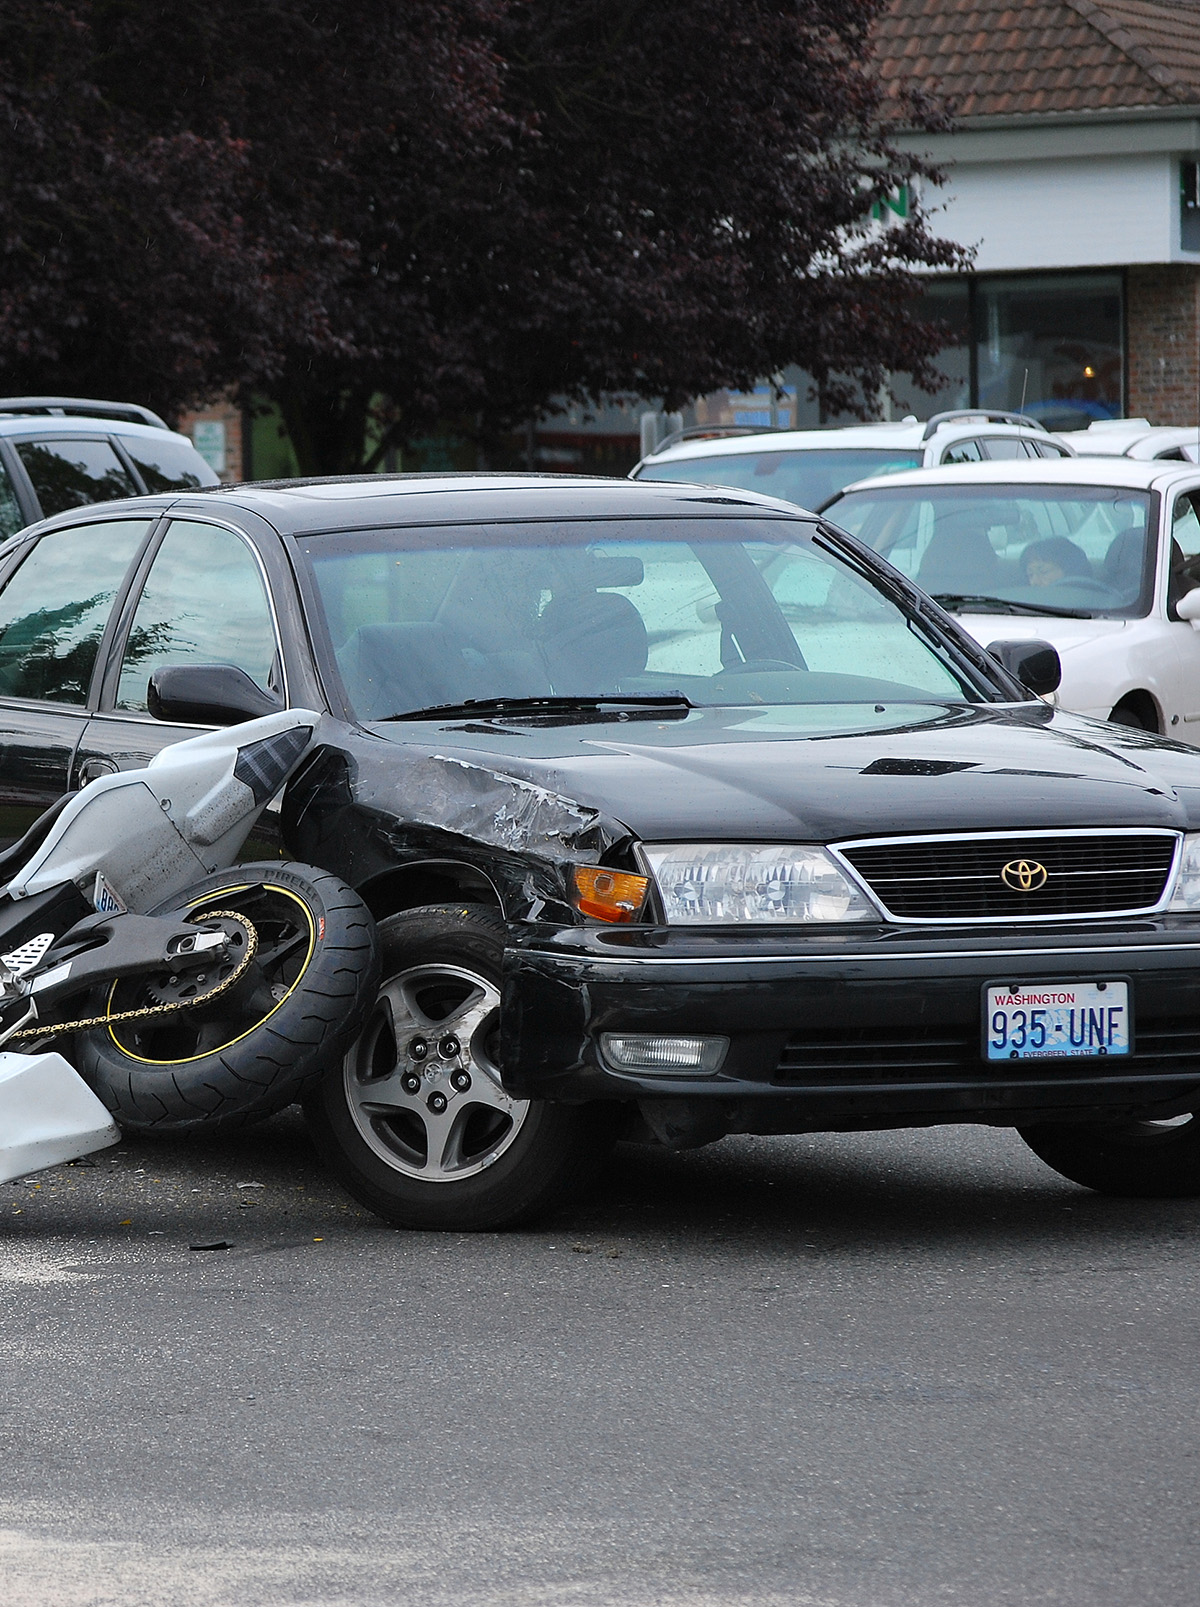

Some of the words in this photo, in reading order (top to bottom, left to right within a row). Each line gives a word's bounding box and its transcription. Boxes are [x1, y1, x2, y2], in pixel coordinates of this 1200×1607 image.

[264, 869, 319, 901] PIRELLI
[994, 992, 1075, 1006] WASHINGTON
[992, 1006, 1123, 1048] 935-UNF
[1023, 1050, 1067, 1058] EVERGREEN
[1071, 1049, 1094, 1057] STATE
